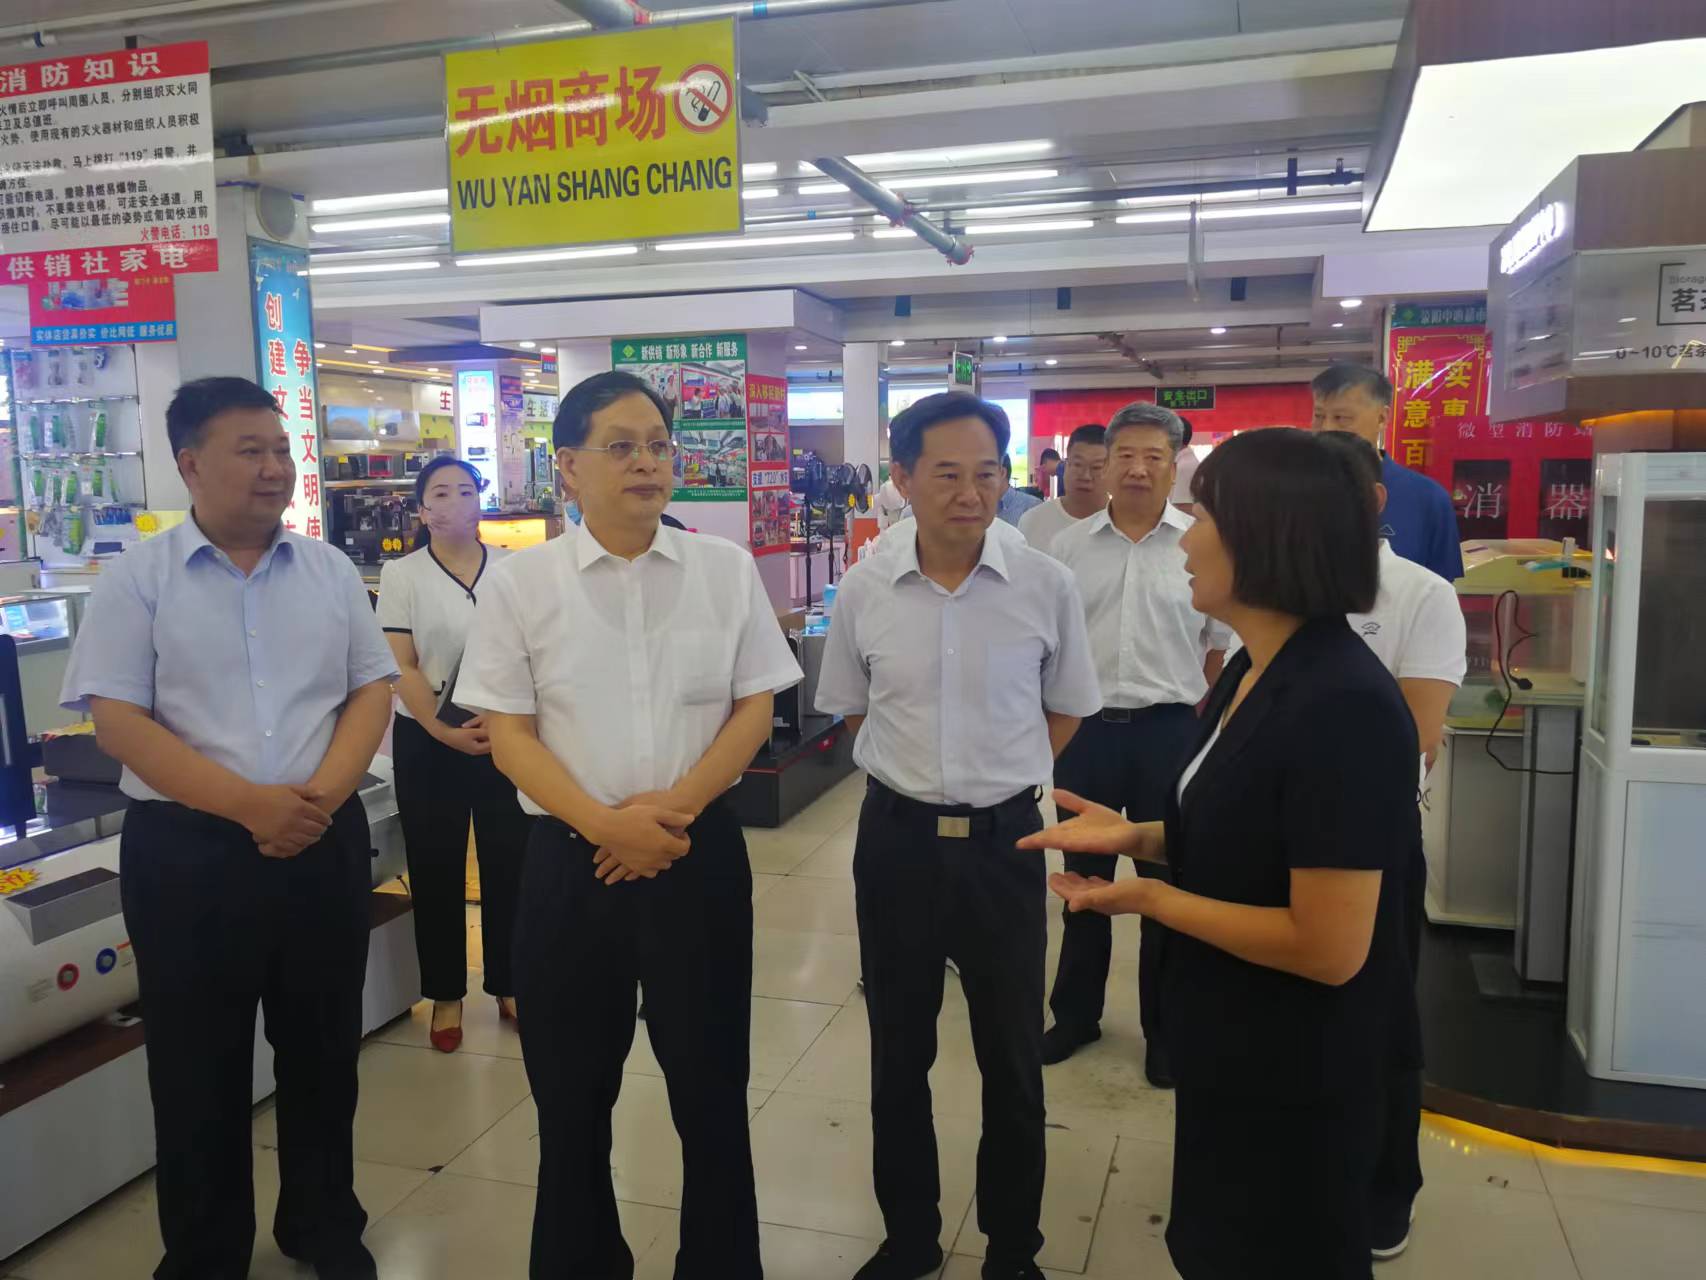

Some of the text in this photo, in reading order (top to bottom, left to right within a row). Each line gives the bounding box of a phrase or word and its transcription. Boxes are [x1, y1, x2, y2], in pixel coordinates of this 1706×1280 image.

[0, 51, 160, 93] 消防知识
[455, 65, 667, 158] 无烟商场
[457, 156, 732, 210] WU YAN SHANG CHANG
[7, 245, 188, 281] 供销社家电
[1671, 287, 1706, 313] 茗
[440, 390, 451, 411] 生
[1163, 390, 1208, 401] 安全出口
[1464, 482, 1504, 520] 消
[1544, 483, 1588, 521] 器
